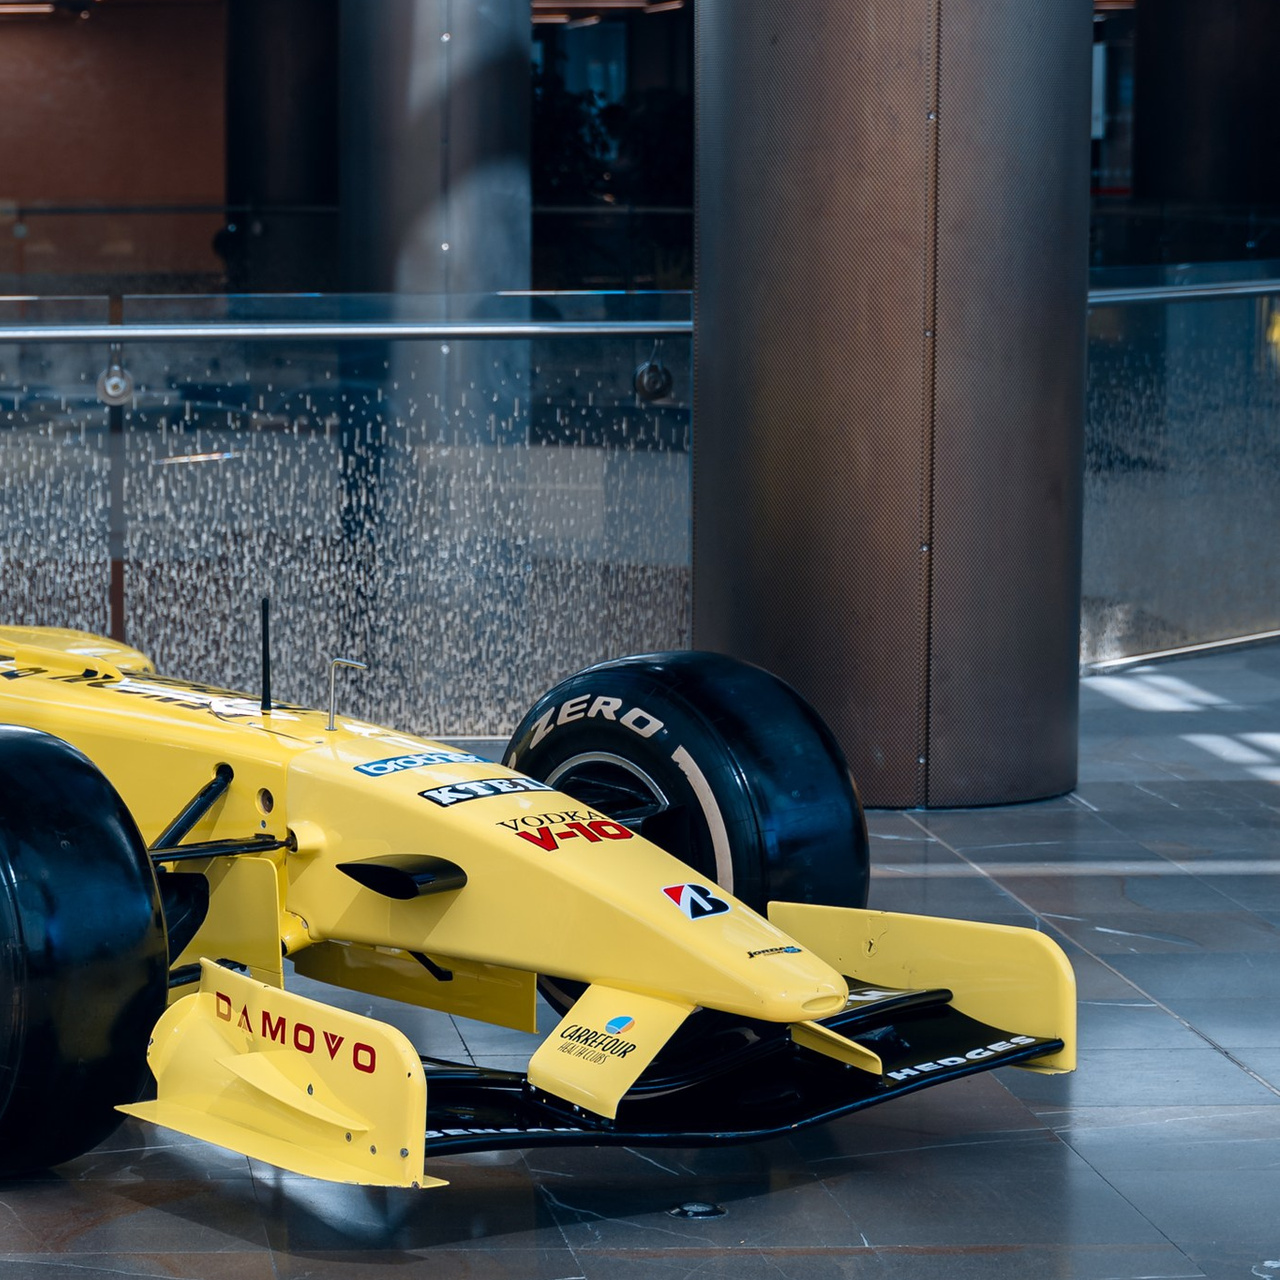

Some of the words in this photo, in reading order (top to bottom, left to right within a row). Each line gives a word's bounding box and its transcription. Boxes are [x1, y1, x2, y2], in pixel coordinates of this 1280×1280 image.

[529, 693, 665, 750] ZERO
[495, 809, 615, 832] VODKA
[515, 820, 635, 852] V-10
[215, 991, 377, 1074] DAMOVO
[559, 1023, 637, 1059] CARREFOUR
[885, 1035, 1037, 1081] HEDGES
